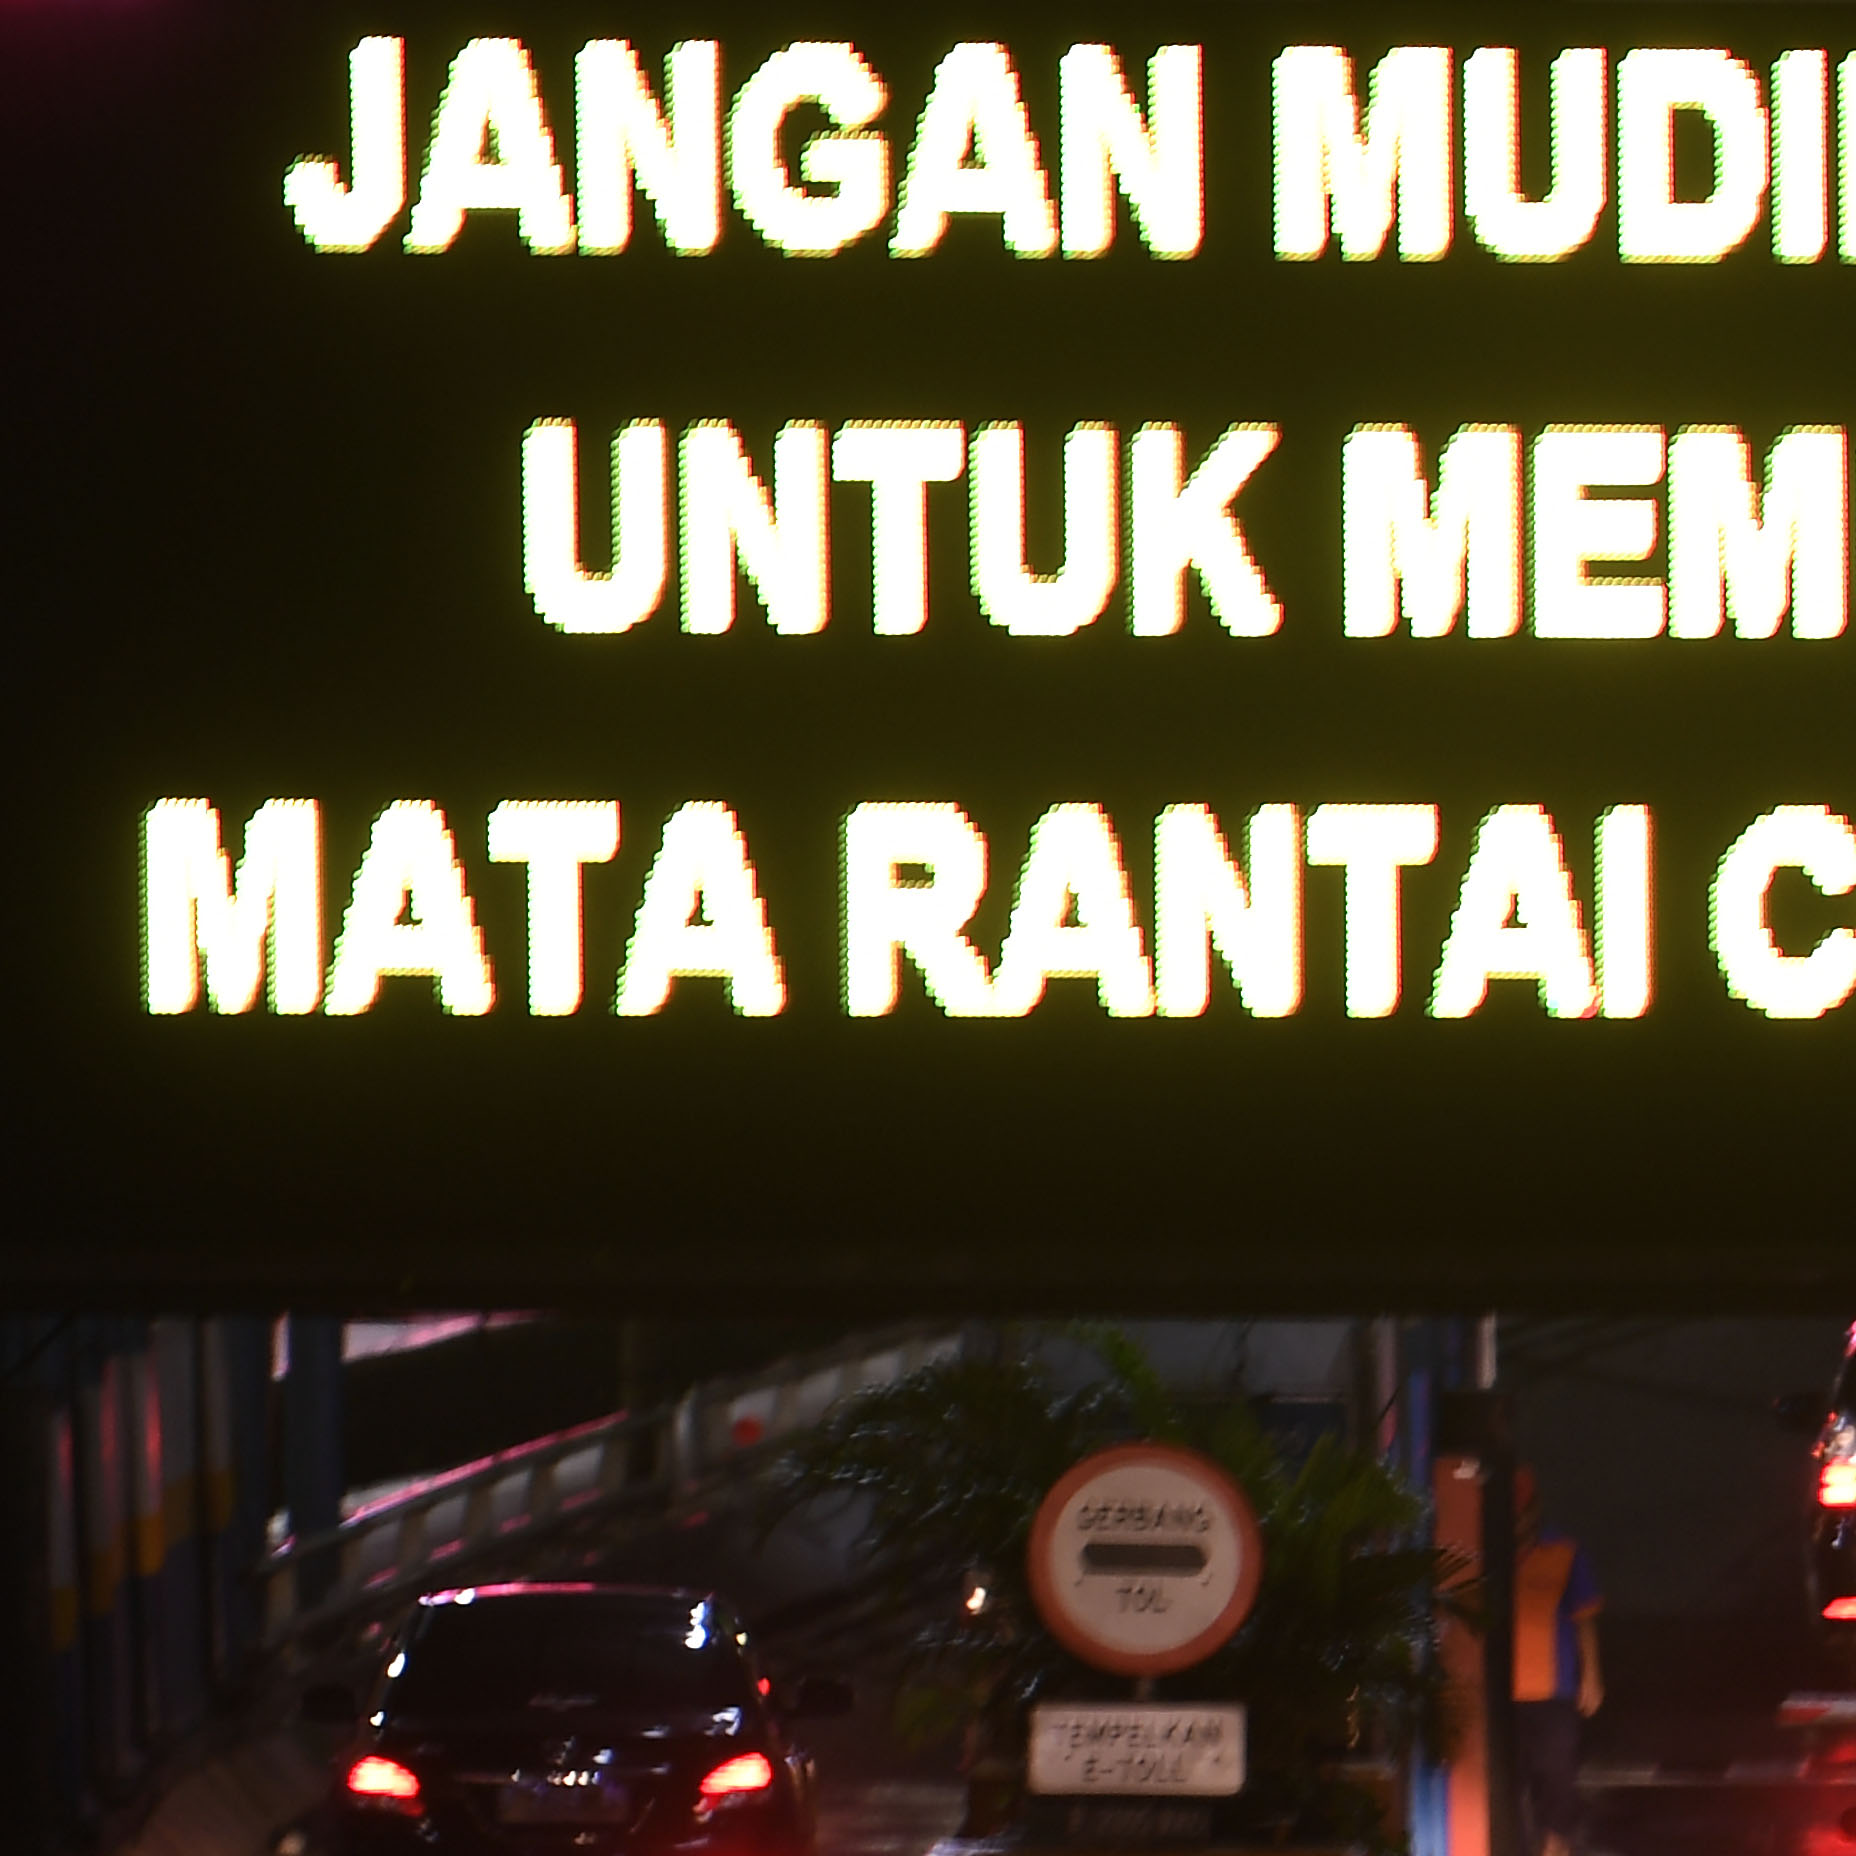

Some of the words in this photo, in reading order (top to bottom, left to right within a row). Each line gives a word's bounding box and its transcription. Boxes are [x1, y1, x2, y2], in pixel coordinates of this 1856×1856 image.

[284, 36, 1205, 260] JANGAN
[522, 417, 1284, 637] UNTUK
[141, 798, 787, 1017] MATA
[840, 802, 1654, 1018] RANTAI
[1078, 1500, 1211, 1533] GERBANG
[1116, 1581, 1171, 1615] TOL
[1083, 1756, 1188, 1784] E-TOLL
